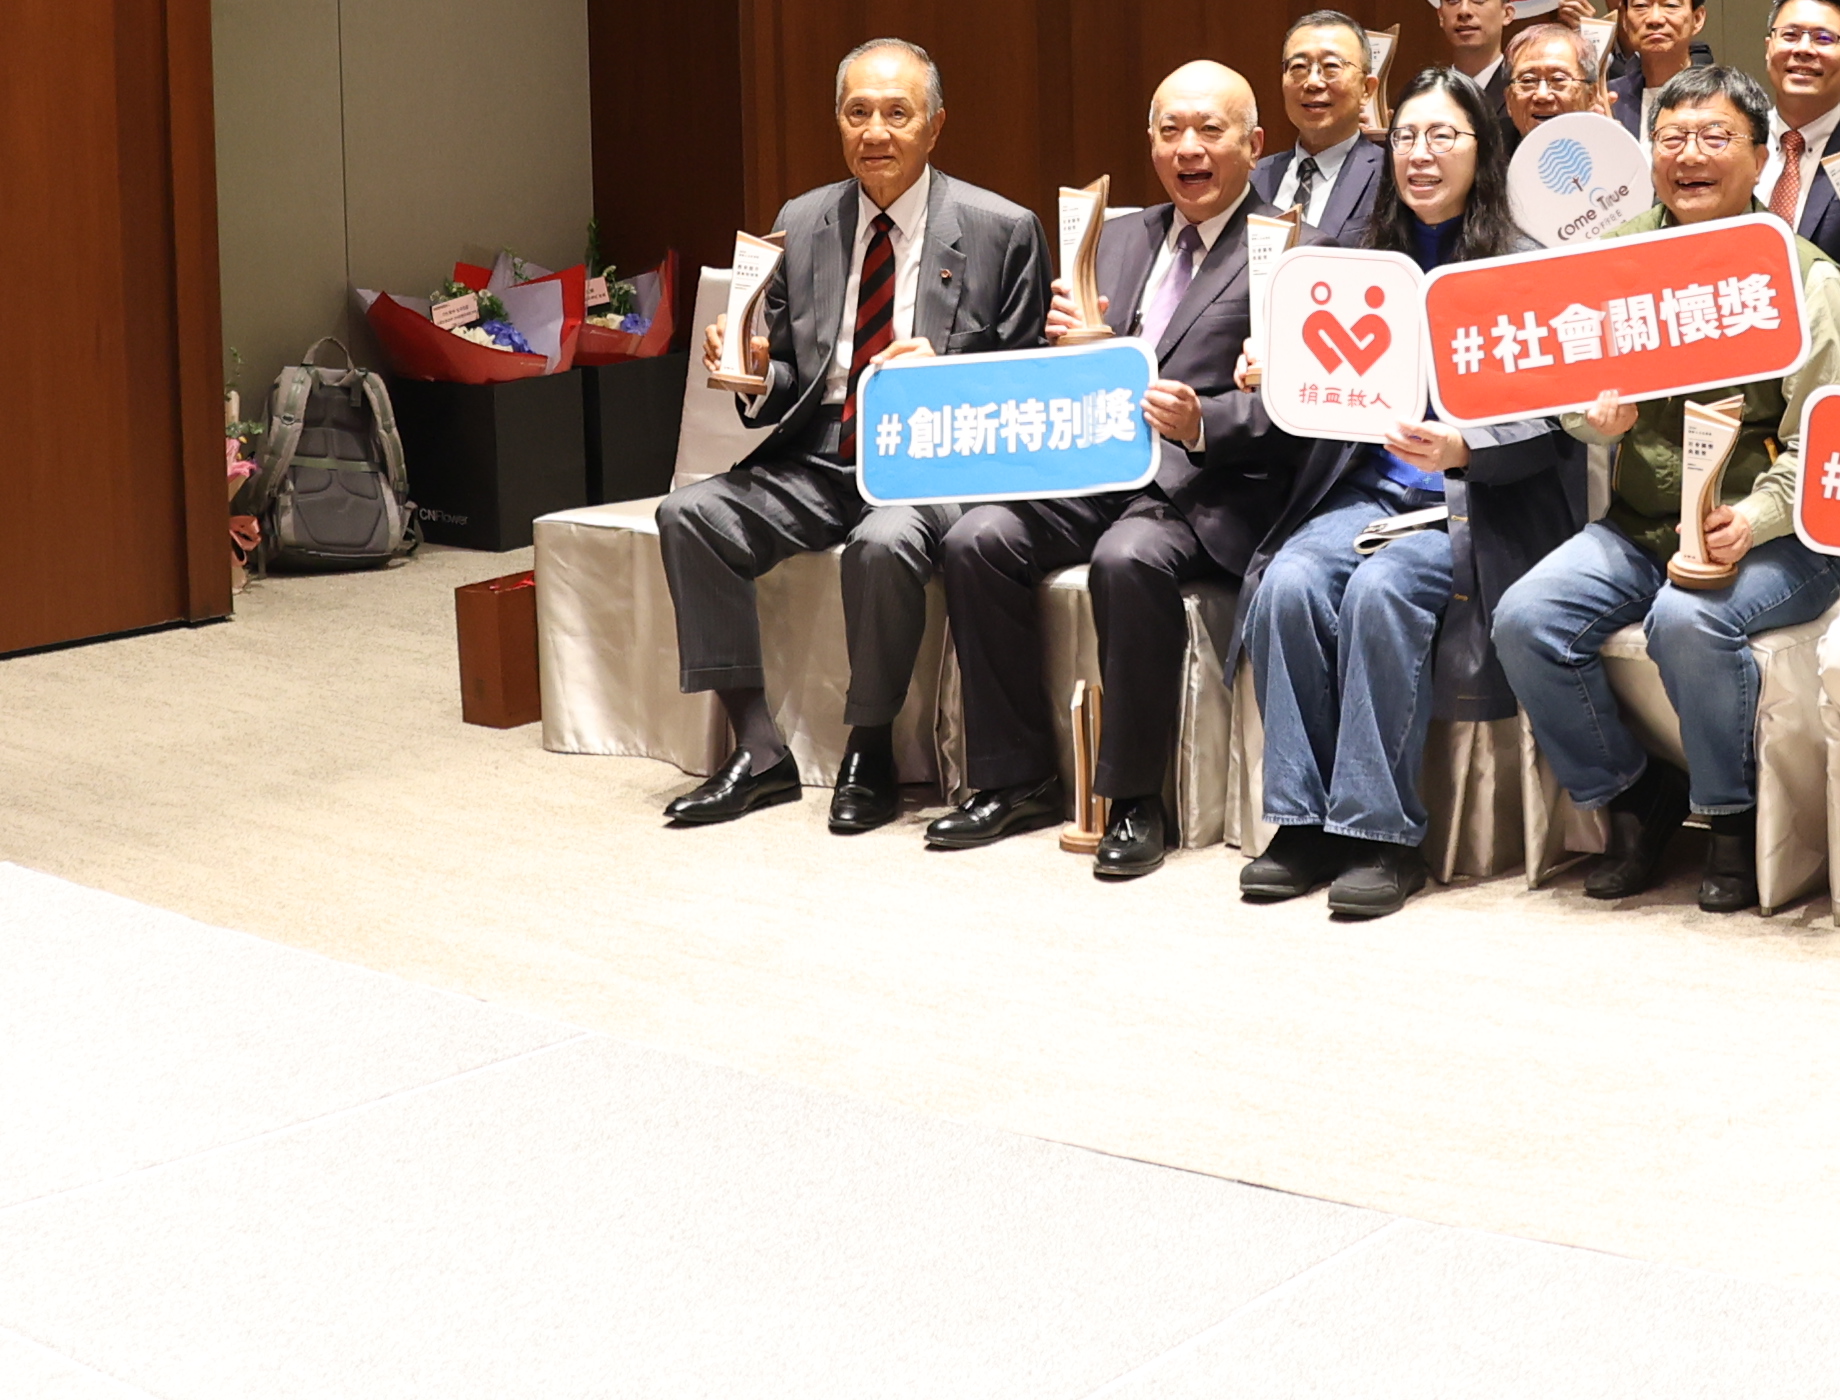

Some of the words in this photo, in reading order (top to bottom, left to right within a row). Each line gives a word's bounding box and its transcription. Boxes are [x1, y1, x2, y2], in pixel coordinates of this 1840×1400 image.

[1557, 209, 1598, 241] Come
[1451, 273, 1782, 375] #社會關懷獎
[1298, 382, 1392, 409] 捐血救人
[875, 387, 1137, 460] #創新特別獎
